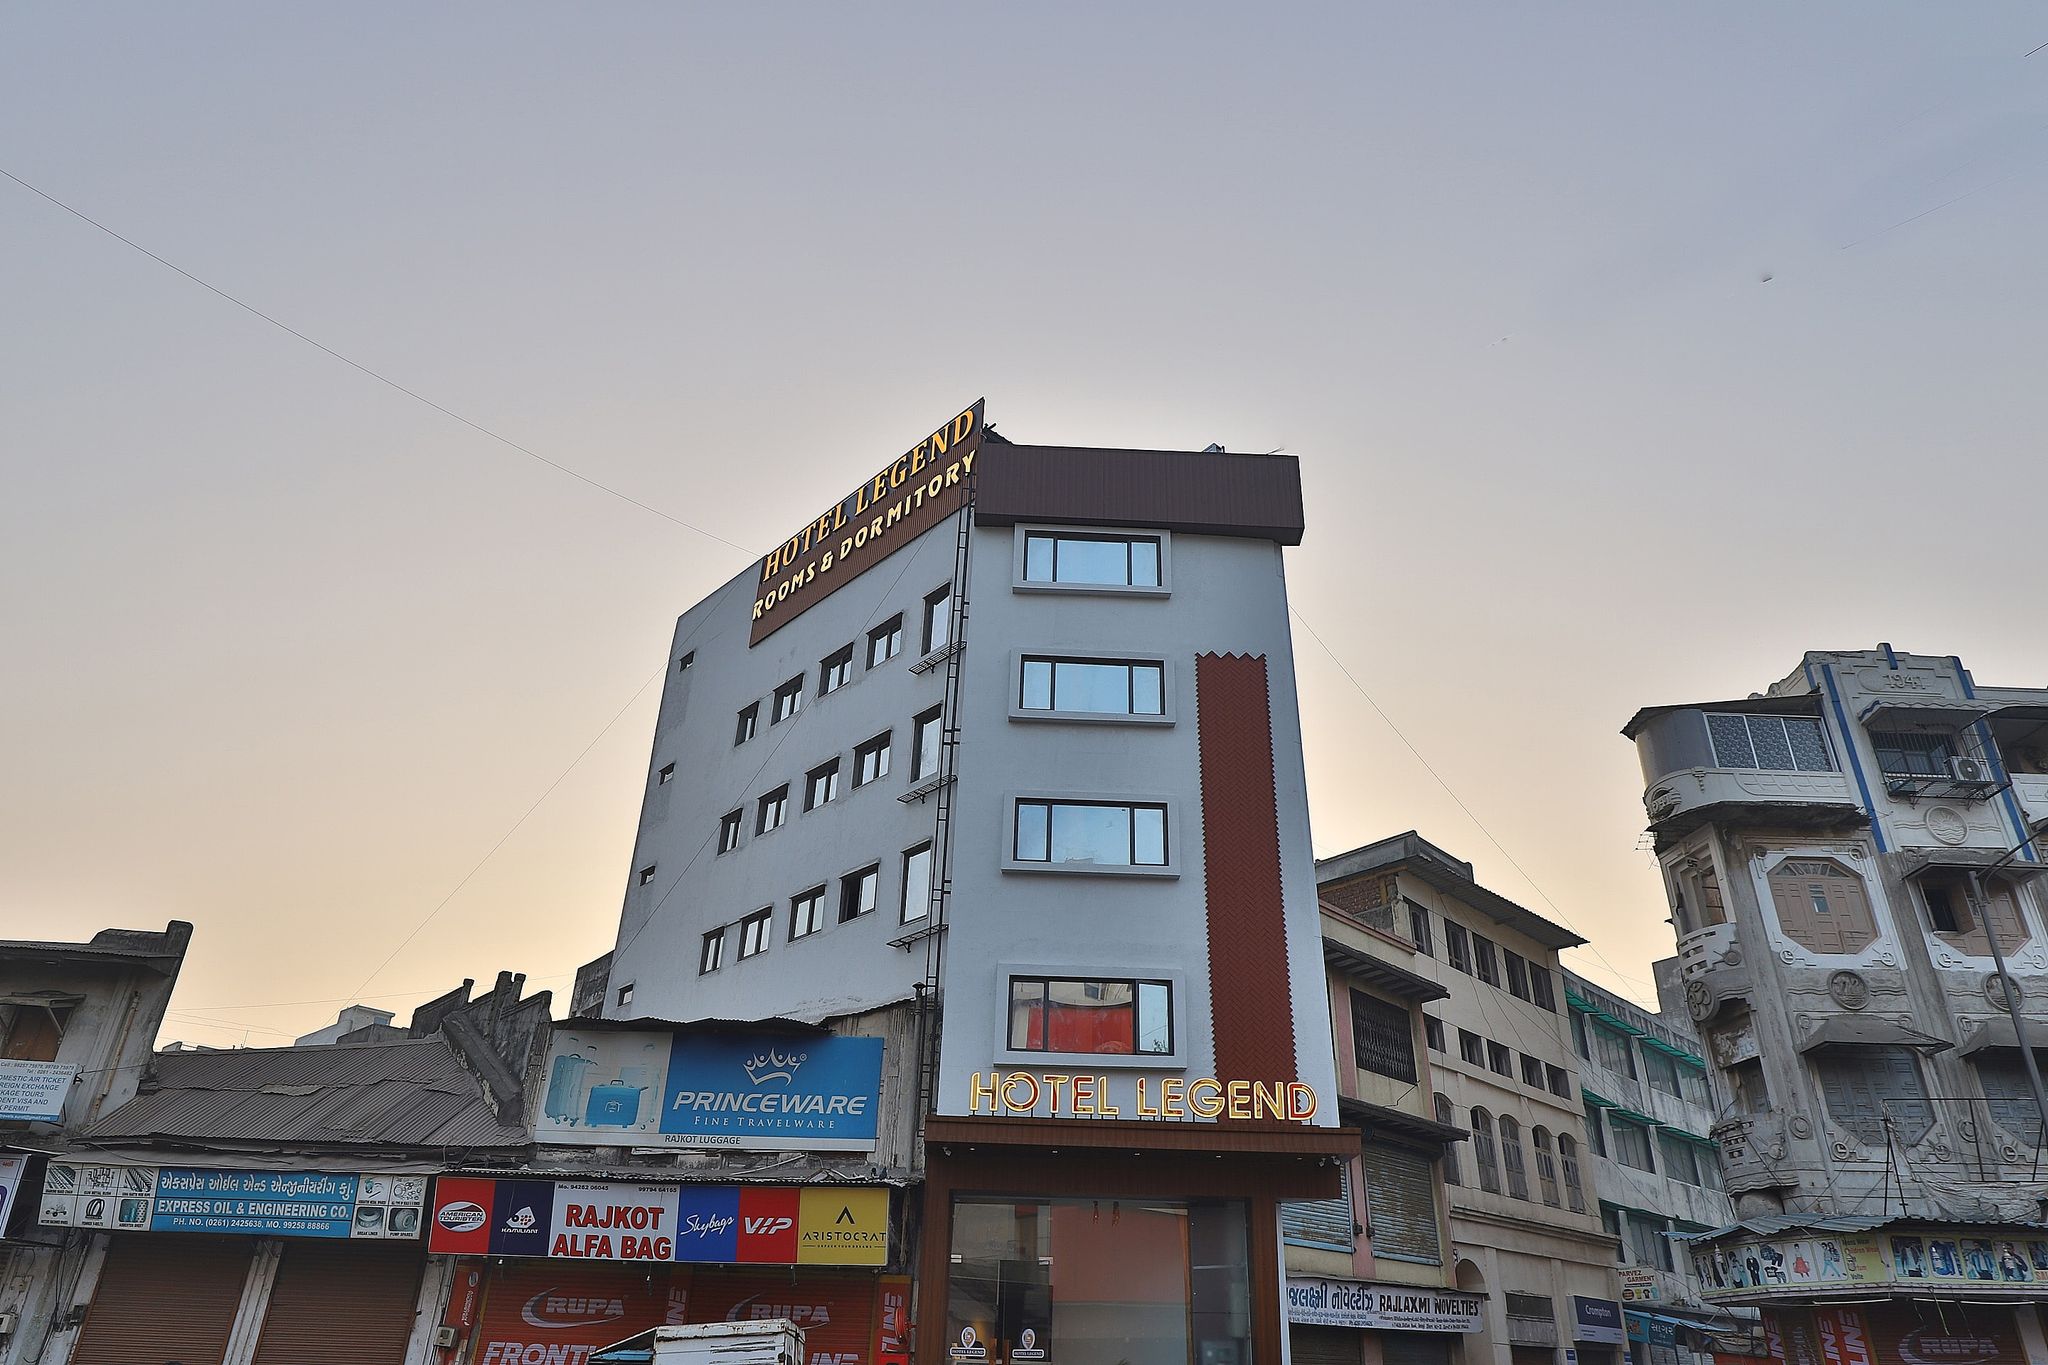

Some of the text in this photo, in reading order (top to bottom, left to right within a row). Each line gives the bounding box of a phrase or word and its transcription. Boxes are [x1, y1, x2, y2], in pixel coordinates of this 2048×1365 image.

[763, 408, 974, 582] HOTEL LEGEND
[752, 450, 976, 620] ROOMS & DORMITORY
[672, 1091, 867, 1115] PRINCEWARE
[969, 1071, 1318, 1122] HOTEL LEGEND
[694, 1116, 835, 1129] FINE TRAVELWARE
[665, 1134, 741, 1144] RAJKOT LUGGAGE
[158, 1200, 348, 1218] EXPRESS OIL & ENGINEERING CO.
[566, 1204, 665, 1230] RAJKOT
[173, 1217, 186, 1225] PH.
[189, 1218, 203, 1226] NO.
[205, 1218, 229, 1228] (0261)
[265, 1220, 281, 1229] MO.
[680, 1213, 734, 1238] Skybags
[744, 1216, 793, 1235] VIP
[802, 1231, 887, 1242] ARISTOCRAT
[551, 1233, 672, 1260] ALFA BAG
[545, 1297, 625, 1316] RUPA
[750, 1304, 831, 1322] RUPA
[1380, 1295, 1479, 1316] RAJLAXMI NOVELTIES
[1585, 1304, 1611, 1318] Crompton
[1651, 1323, 1673, 1335] સાગર
